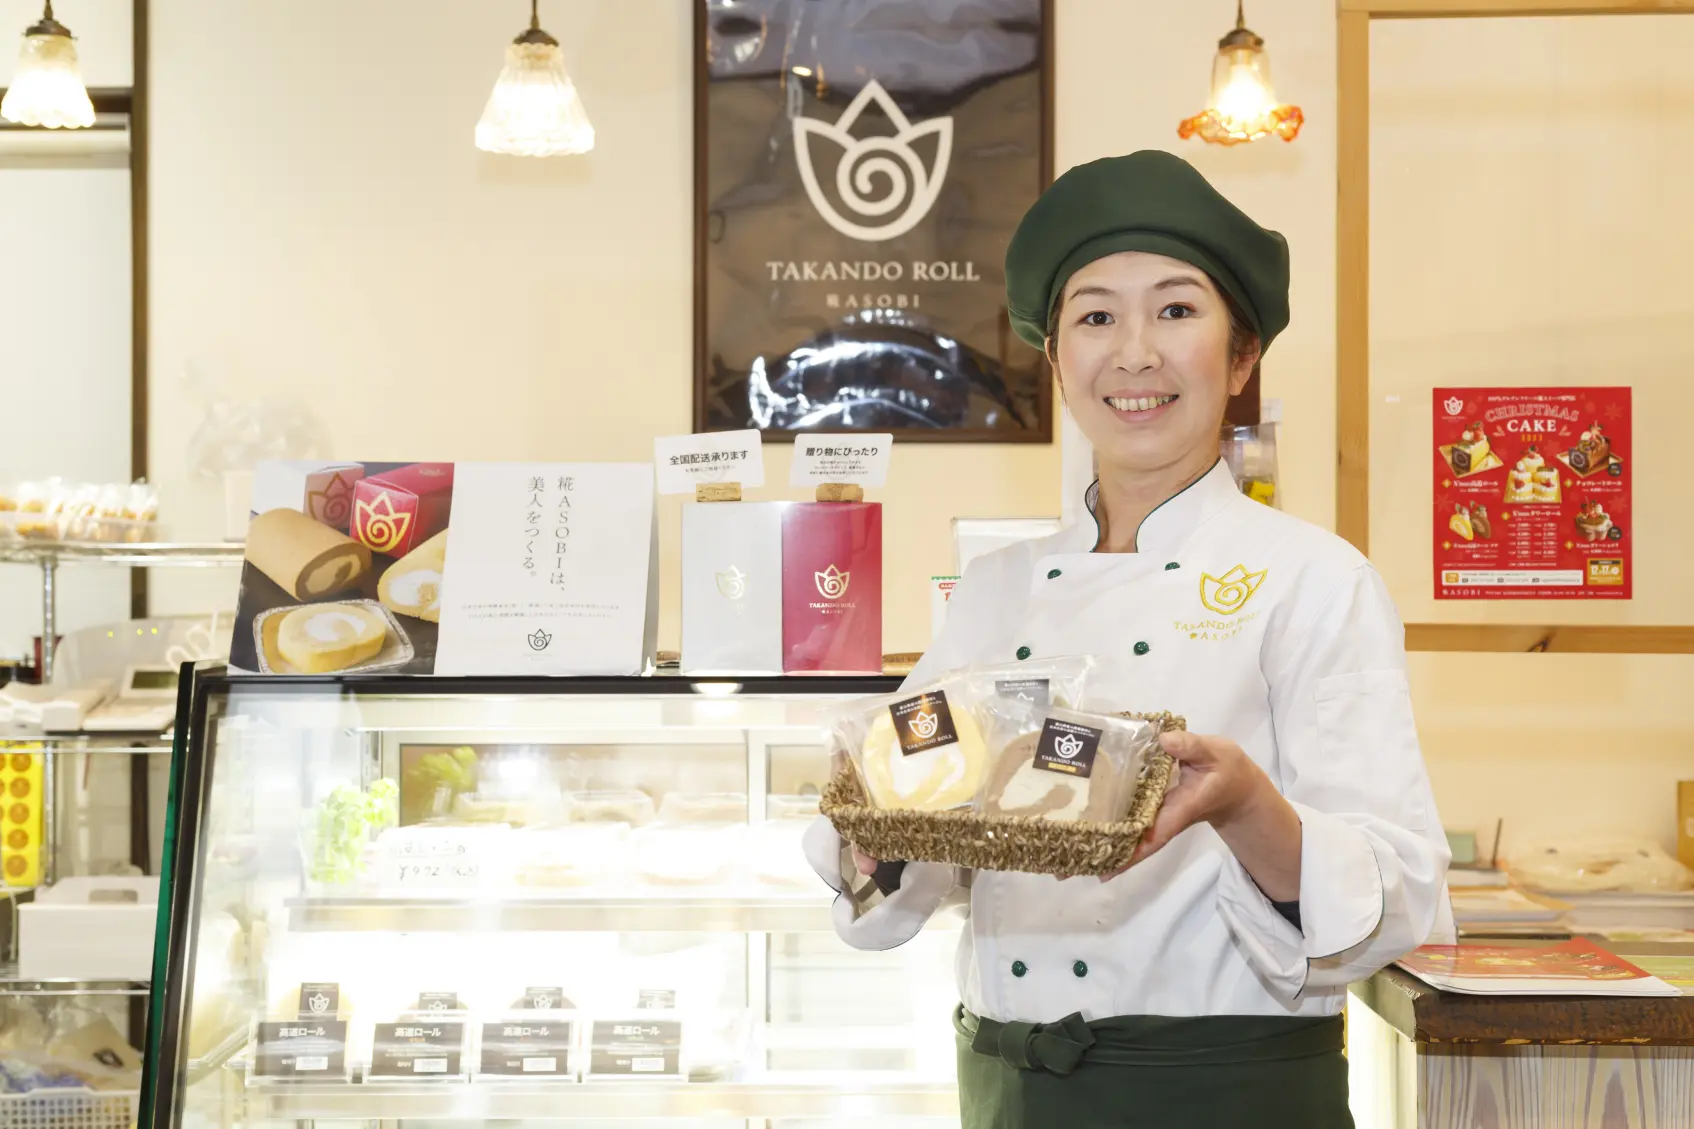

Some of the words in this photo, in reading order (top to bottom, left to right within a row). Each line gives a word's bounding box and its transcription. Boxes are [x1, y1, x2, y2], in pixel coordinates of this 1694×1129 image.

[765, 261, 903, 281] TAKANDO
[912, 261, 981, 281] ROLL
[1485, 403, 1581, 422] CHRISTMAS
[1506, 419, 1557, 433] CAKE
[669, 450, 748, 466] 全国配送承ります
[805, 447, 878, 458] 贈り物にぴったり
